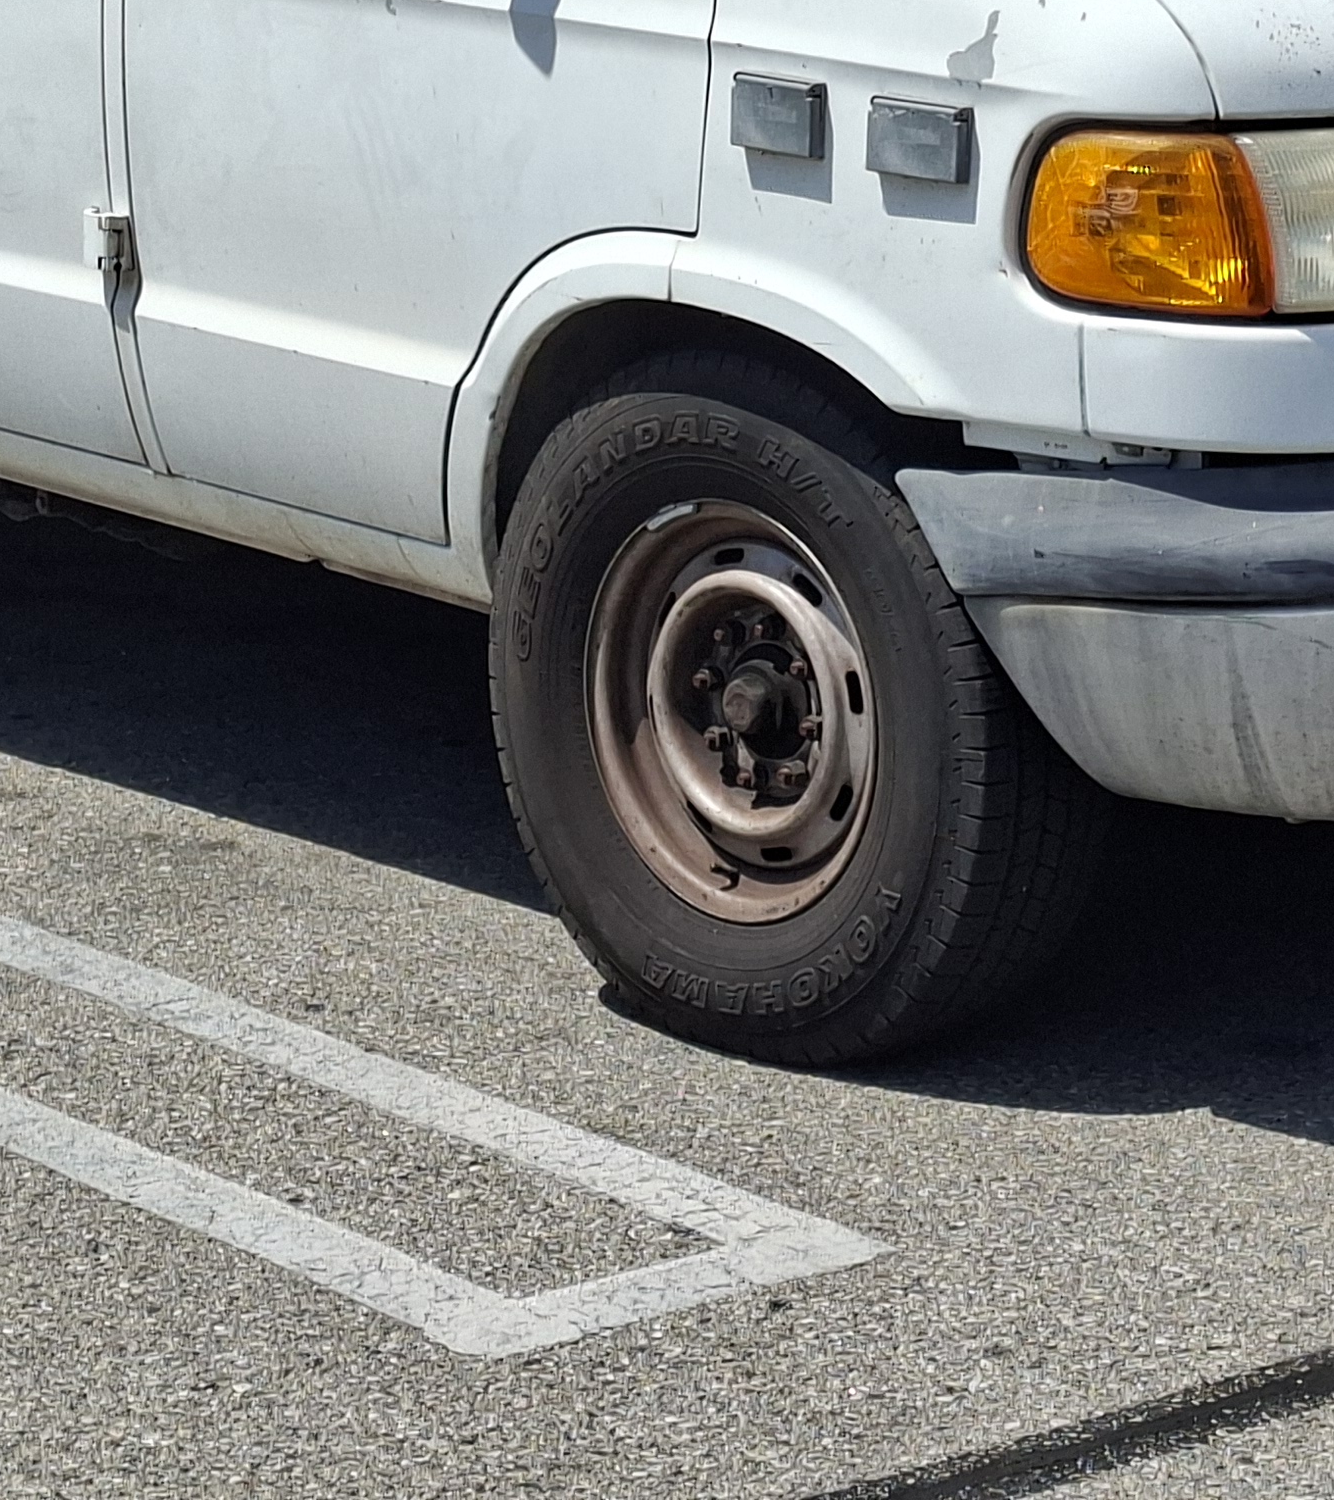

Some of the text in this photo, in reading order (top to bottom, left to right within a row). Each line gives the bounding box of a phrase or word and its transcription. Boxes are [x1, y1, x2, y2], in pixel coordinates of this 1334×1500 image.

[509, 409, 742, 662] GEOLANDAR
[756, 434, 854, 529] H/T
[642, 882, 902, 1015] YOKOHAMA
